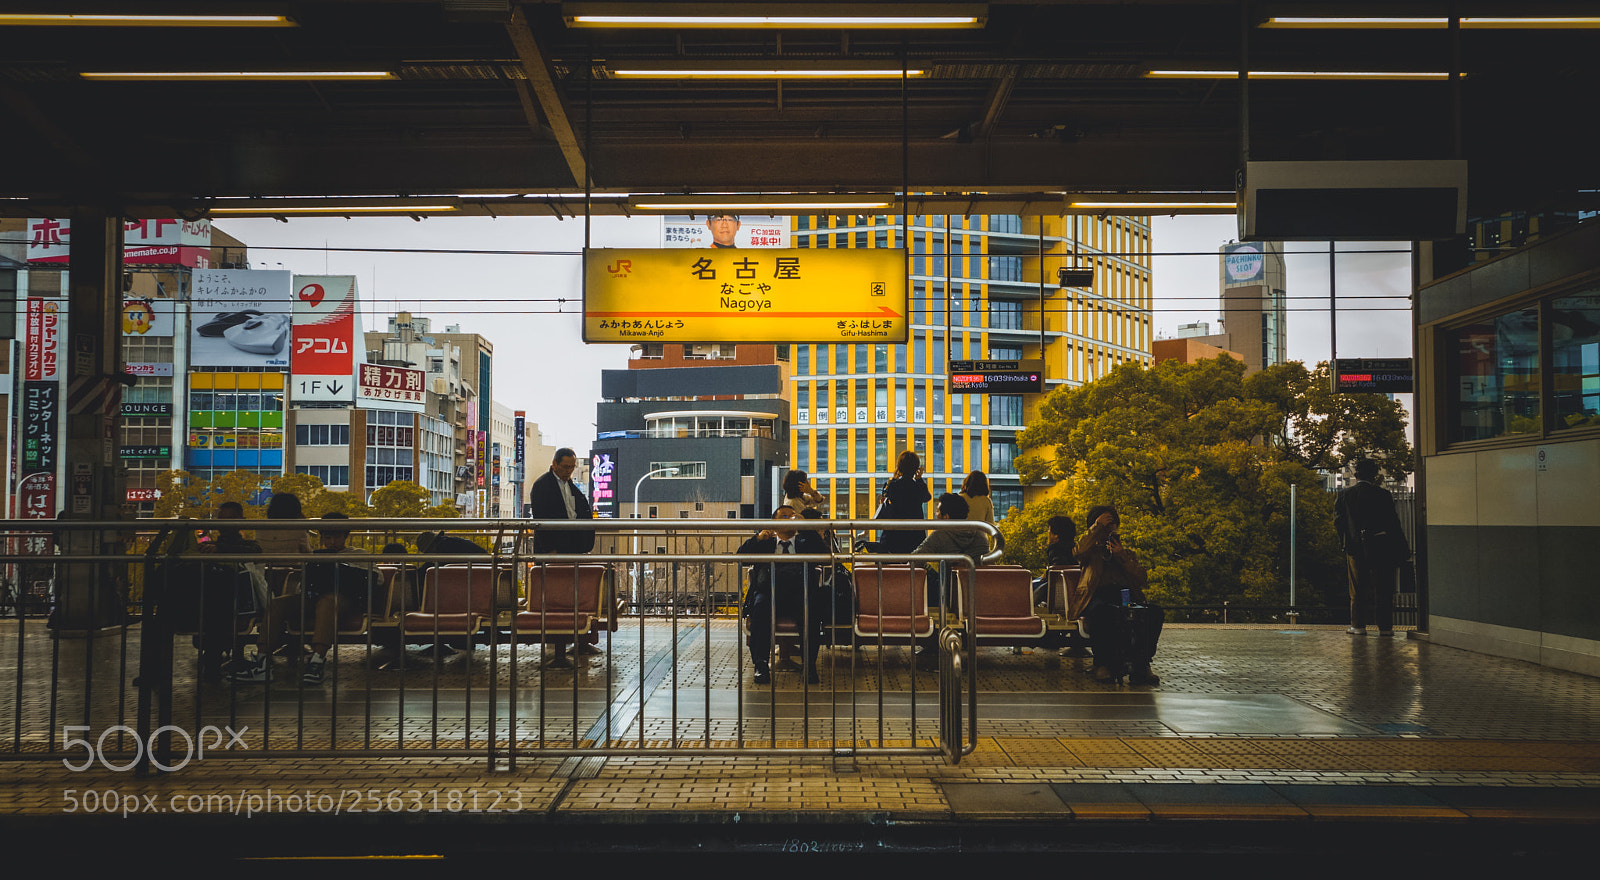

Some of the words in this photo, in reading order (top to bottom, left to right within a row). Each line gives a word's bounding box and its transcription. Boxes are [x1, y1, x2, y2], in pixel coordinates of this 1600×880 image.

[607, 259, 632, 273] JR
[1226, 254, 1262, 265] PACHINKO
[691, 257, 801, 280] 名古屋
[1236, 264, 1253, 272] SLOT
[197, 286, 267, 296] キレイふかふかの
[720, 283, 772, 296] なごや
[872, 283, 885, 296] 名
[720, 297, 772, 311] Nagoya
[599, 319, 685, 329] みかわあんじょう
[837, 320, 893, 329] ぎふはしま
[44, 314, 58, 377] ジャンカラ
[297, 338, 348, 354] アコム
[364, 366, 421, 390] 精力剤
[300, 381, 322, 395] 1F
[28, 388, 40, 435] コミック
[120, 404, 167, 412] OUNGE
[799, 409, 925, 421] 圧倒的合格実績
[40, 387, 53, 467] インターネット
[138, 446, 158, 455] cafe
